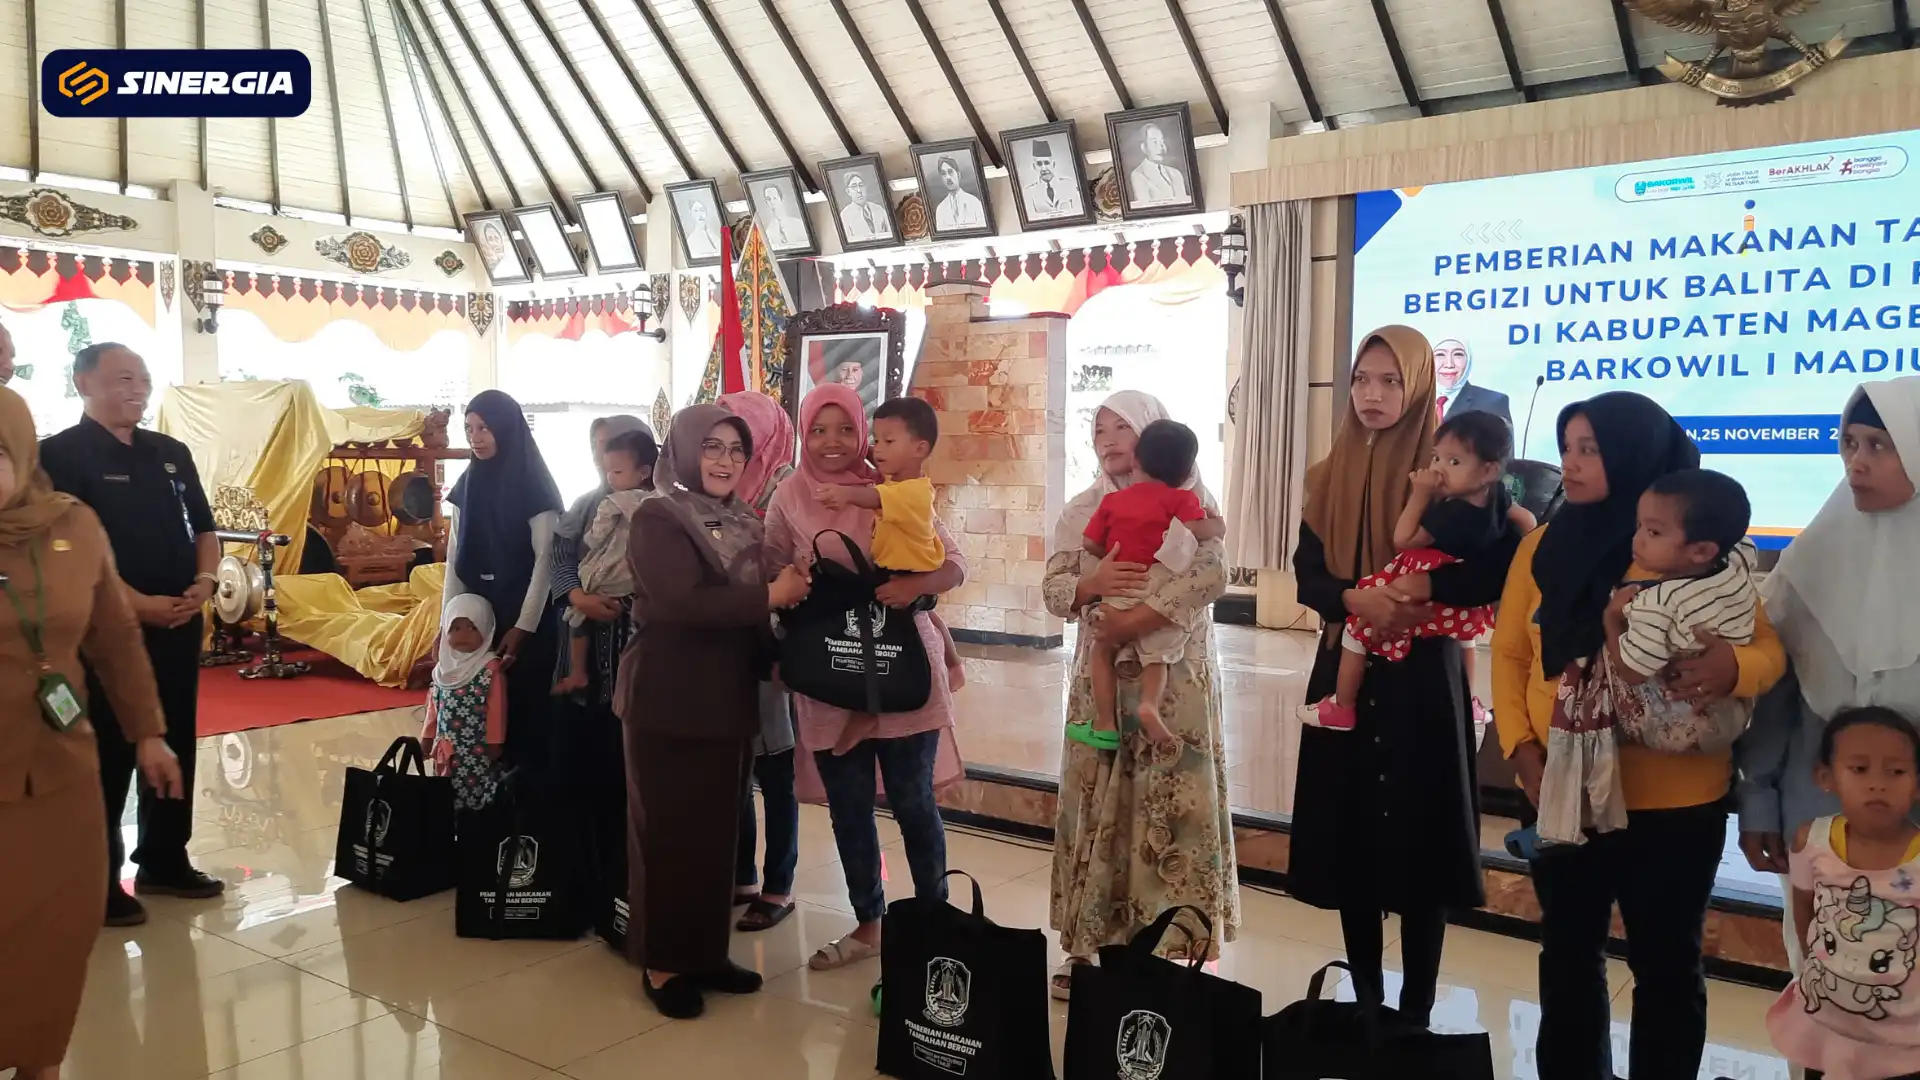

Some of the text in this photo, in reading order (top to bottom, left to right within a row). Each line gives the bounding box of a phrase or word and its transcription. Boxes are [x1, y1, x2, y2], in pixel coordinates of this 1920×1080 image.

[1434, 240, 1632, 276] PEMBERIAN
[1649, 222, 1856, 261] MAKANAN
[1404, 286, 1529, 314] BERGIZI
[1545, 277, 1668, 306] UNTUK
[1685, 267, 1831, 298] BALITA
[1850, 263, 1891, 288] DI
[1508, 323, 1540, 345] DI
[1556, 311, 1788, 343] KABUPATEN
[1546, 353, 1749, 381] BARKOWIL
[1767, 352, 1775, 376] I
[1725, 428, 1820, 440] NOVEMBER
[905, 1019, 982, 1048] PEMBERIAN MAKANAN
[909, 1028, 976, 1056] TAMBAHAN BERGIZI
